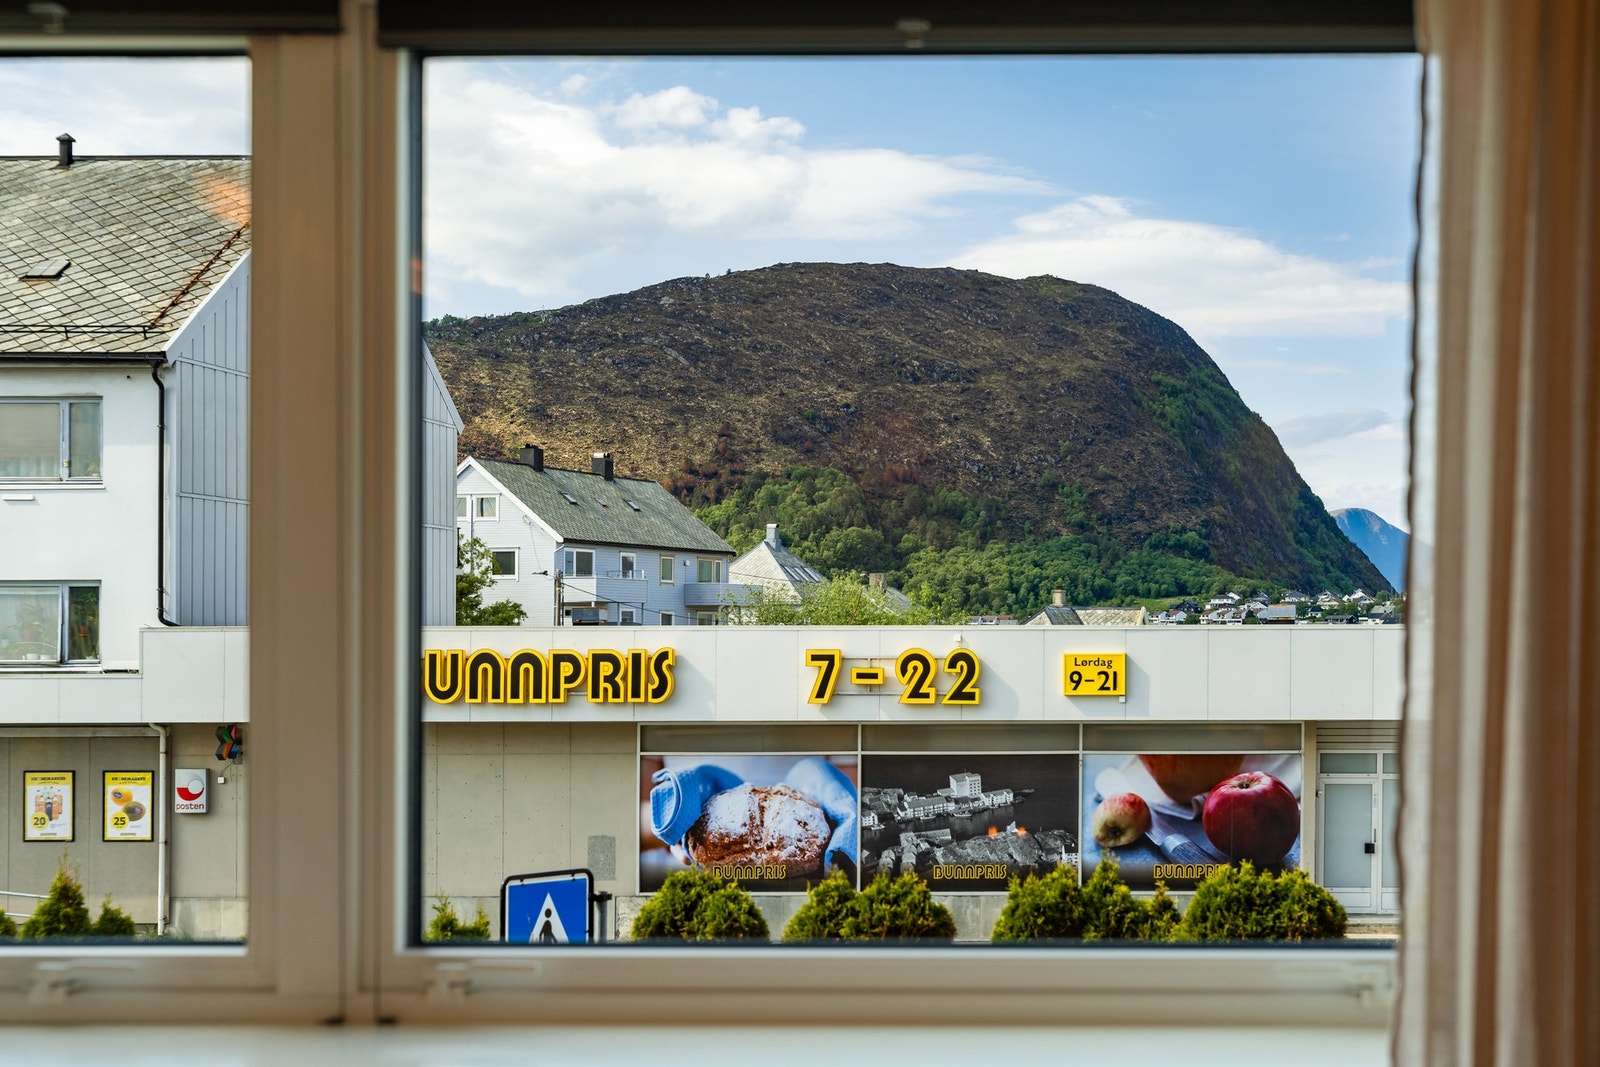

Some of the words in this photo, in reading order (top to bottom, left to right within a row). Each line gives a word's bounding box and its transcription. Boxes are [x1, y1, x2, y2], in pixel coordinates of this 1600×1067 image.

[1074, 657, 1113, 670] Lørdag
[423, 647, 676, 704] UNNPRIS
[176, 803, 205, 811] posten
[33, 816, 46, 826] 20
[113, 816, 126, 826] 25
[712, 864, 787, 880] BUNNPRIS
[933, 864, 1007, 879] BUNNPRIS
[1153, 863, 1221, 879] BUNNPR
